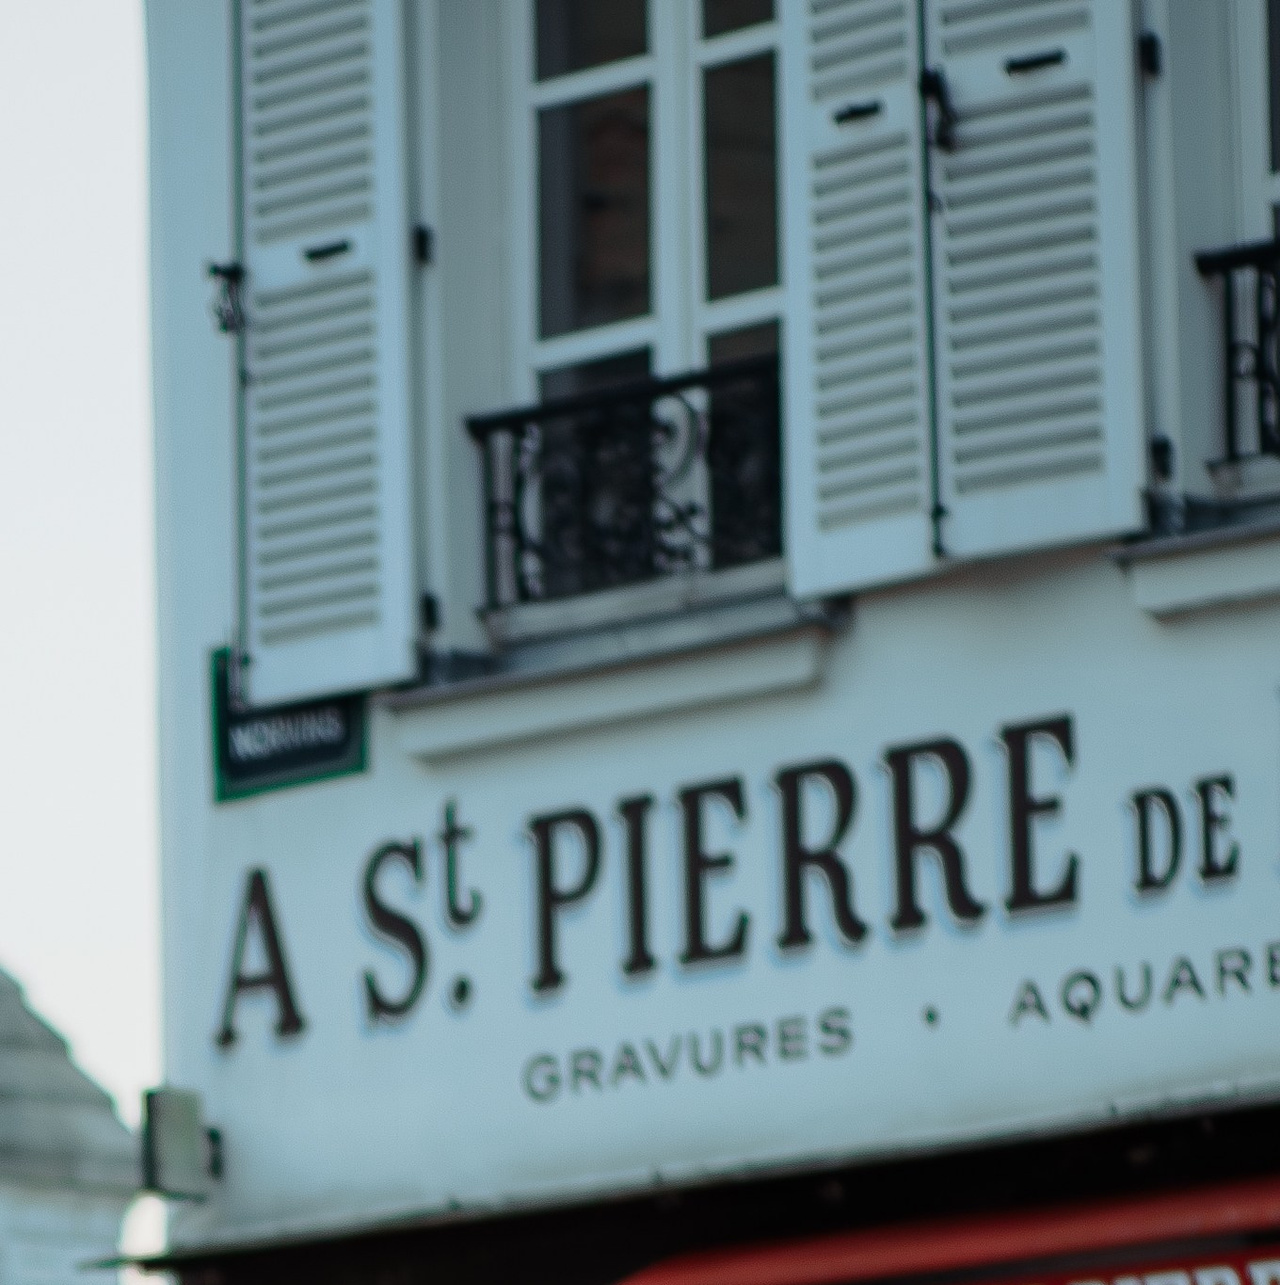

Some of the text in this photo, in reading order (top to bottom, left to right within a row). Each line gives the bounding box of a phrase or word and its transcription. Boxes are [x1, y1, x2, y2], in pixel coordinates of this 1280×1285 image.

[216, 866, 304, 1046] A
[526, 714, 1080, 993] PIERRE
[1128, 772, 1241, 893] DE
[522, 1006, 855, 1104] GRAVURES
